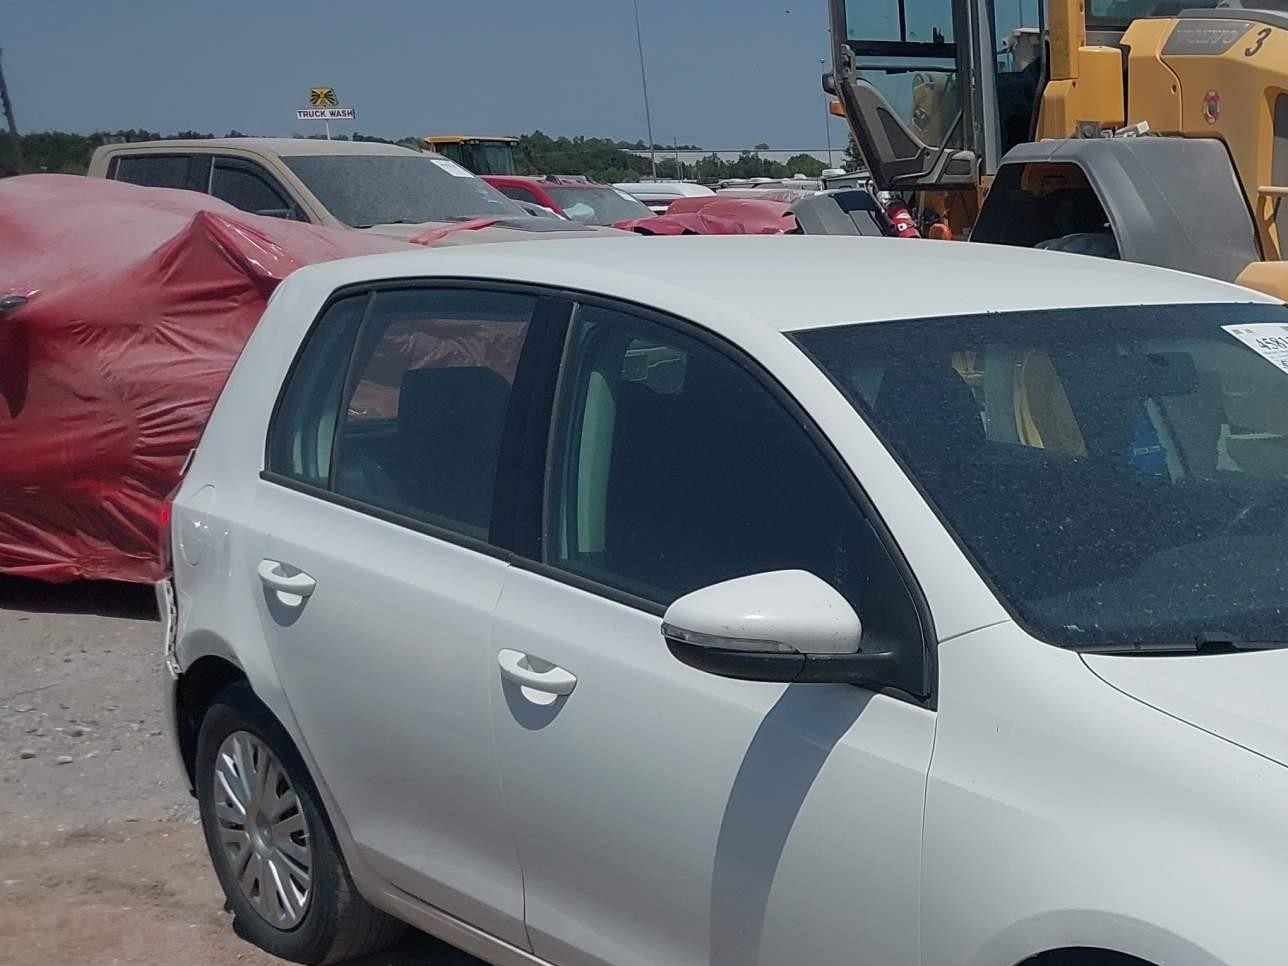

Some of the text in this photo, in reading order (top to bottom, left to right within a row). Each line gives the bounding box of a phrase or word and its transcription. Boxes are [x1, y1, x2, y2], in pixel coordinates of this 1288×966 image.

[1244, 27, 1273, 57] 3
[297, 109, 353, 118] TRUCK WASH
